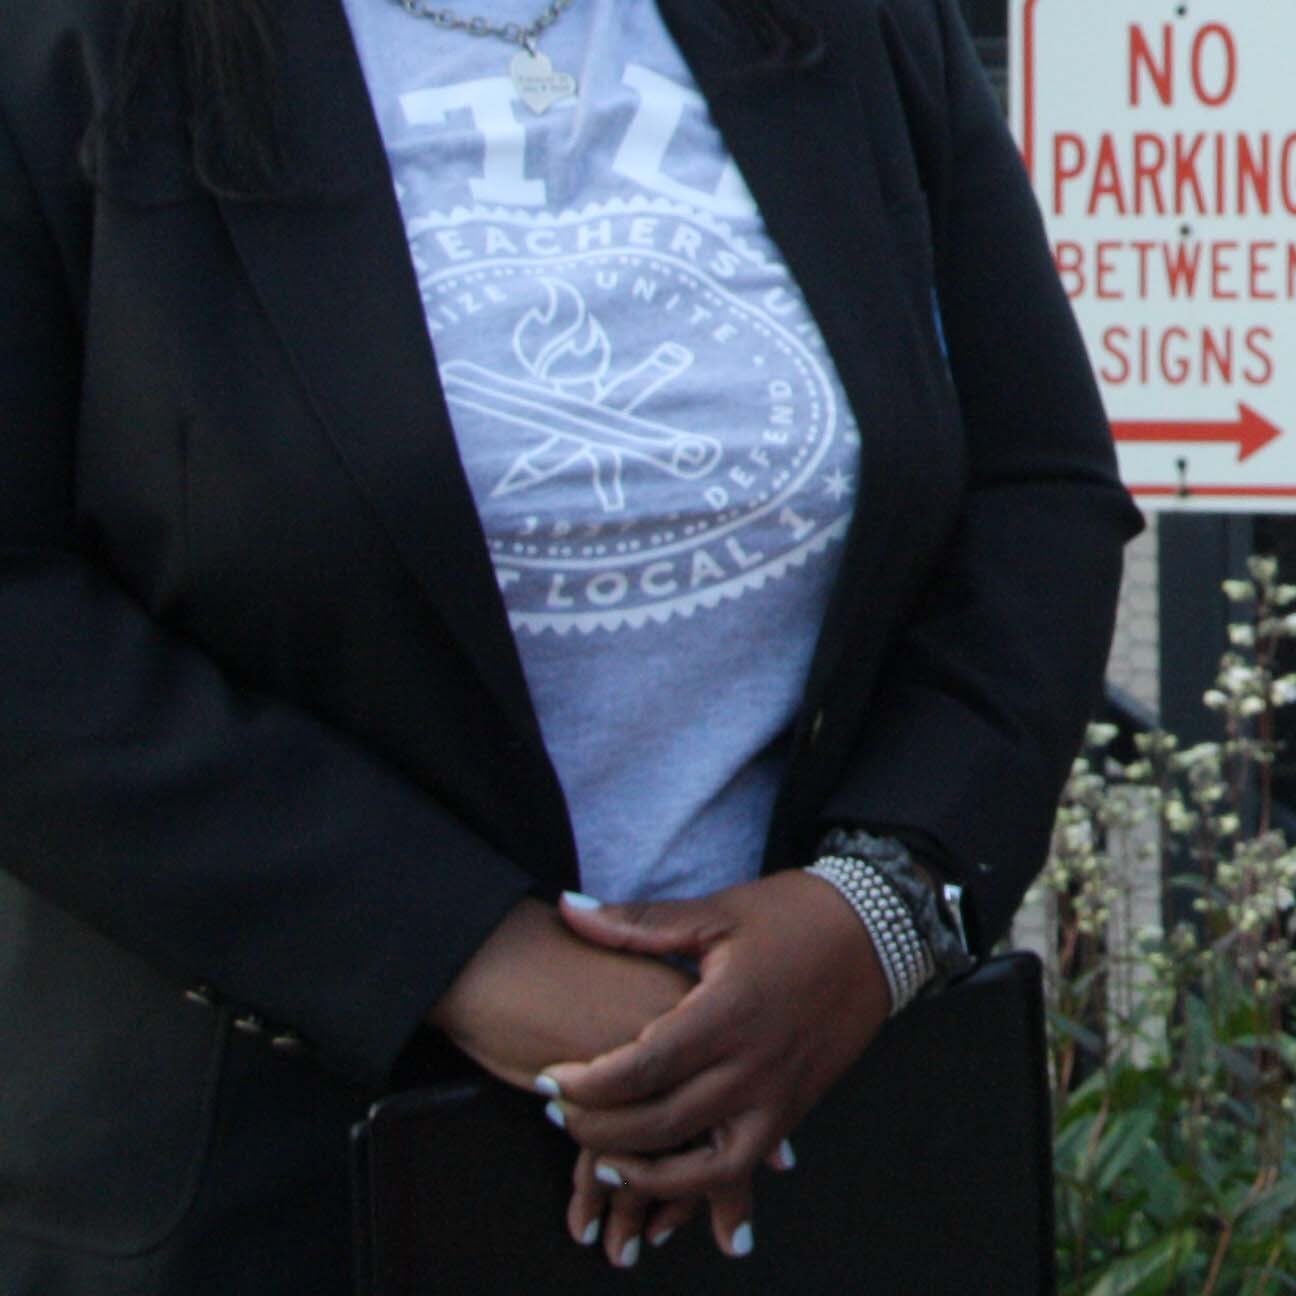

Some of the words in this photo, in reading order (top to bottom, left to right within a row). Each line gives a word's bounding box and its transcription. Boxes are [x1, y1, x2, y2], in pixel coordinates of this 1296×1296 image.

[1128, 23, 1237, 108] NO
[412, 218, 742, 278] EACHERS
[596, 271, 738, 344] UNITE
[1100, 326, 1274, 385] SIGNS
[704, 379, 794, 510] DEFEND
[546, 516, 763, 607] LOCAL
